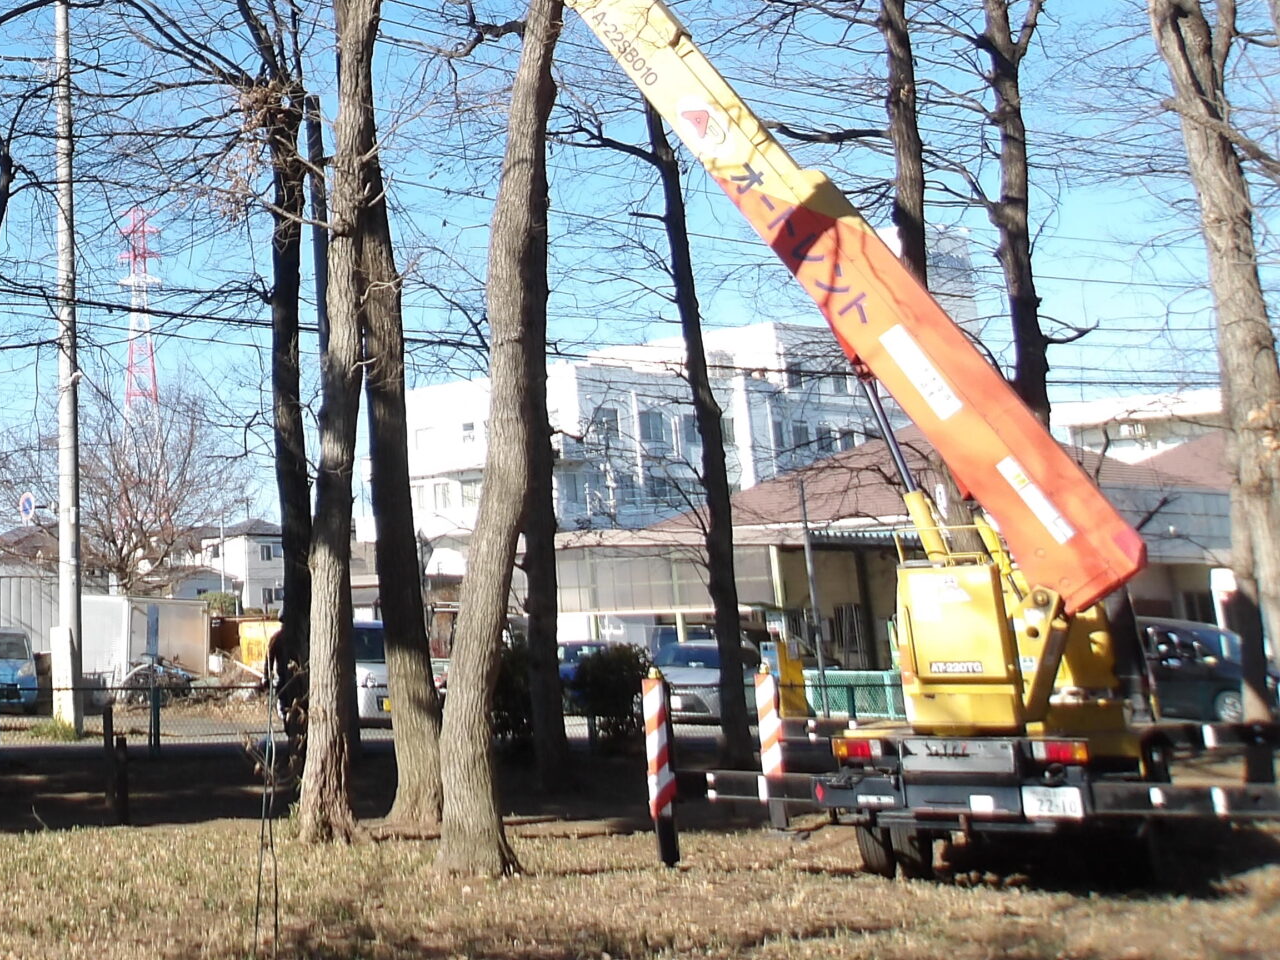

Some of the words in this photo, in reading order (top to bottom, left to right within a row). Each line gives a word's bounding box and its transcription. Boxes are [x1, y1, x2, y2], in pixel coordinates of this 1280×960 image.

[591, 11, 658, 87] A-22SB010
[731, 162, 868, 324] オートレント
